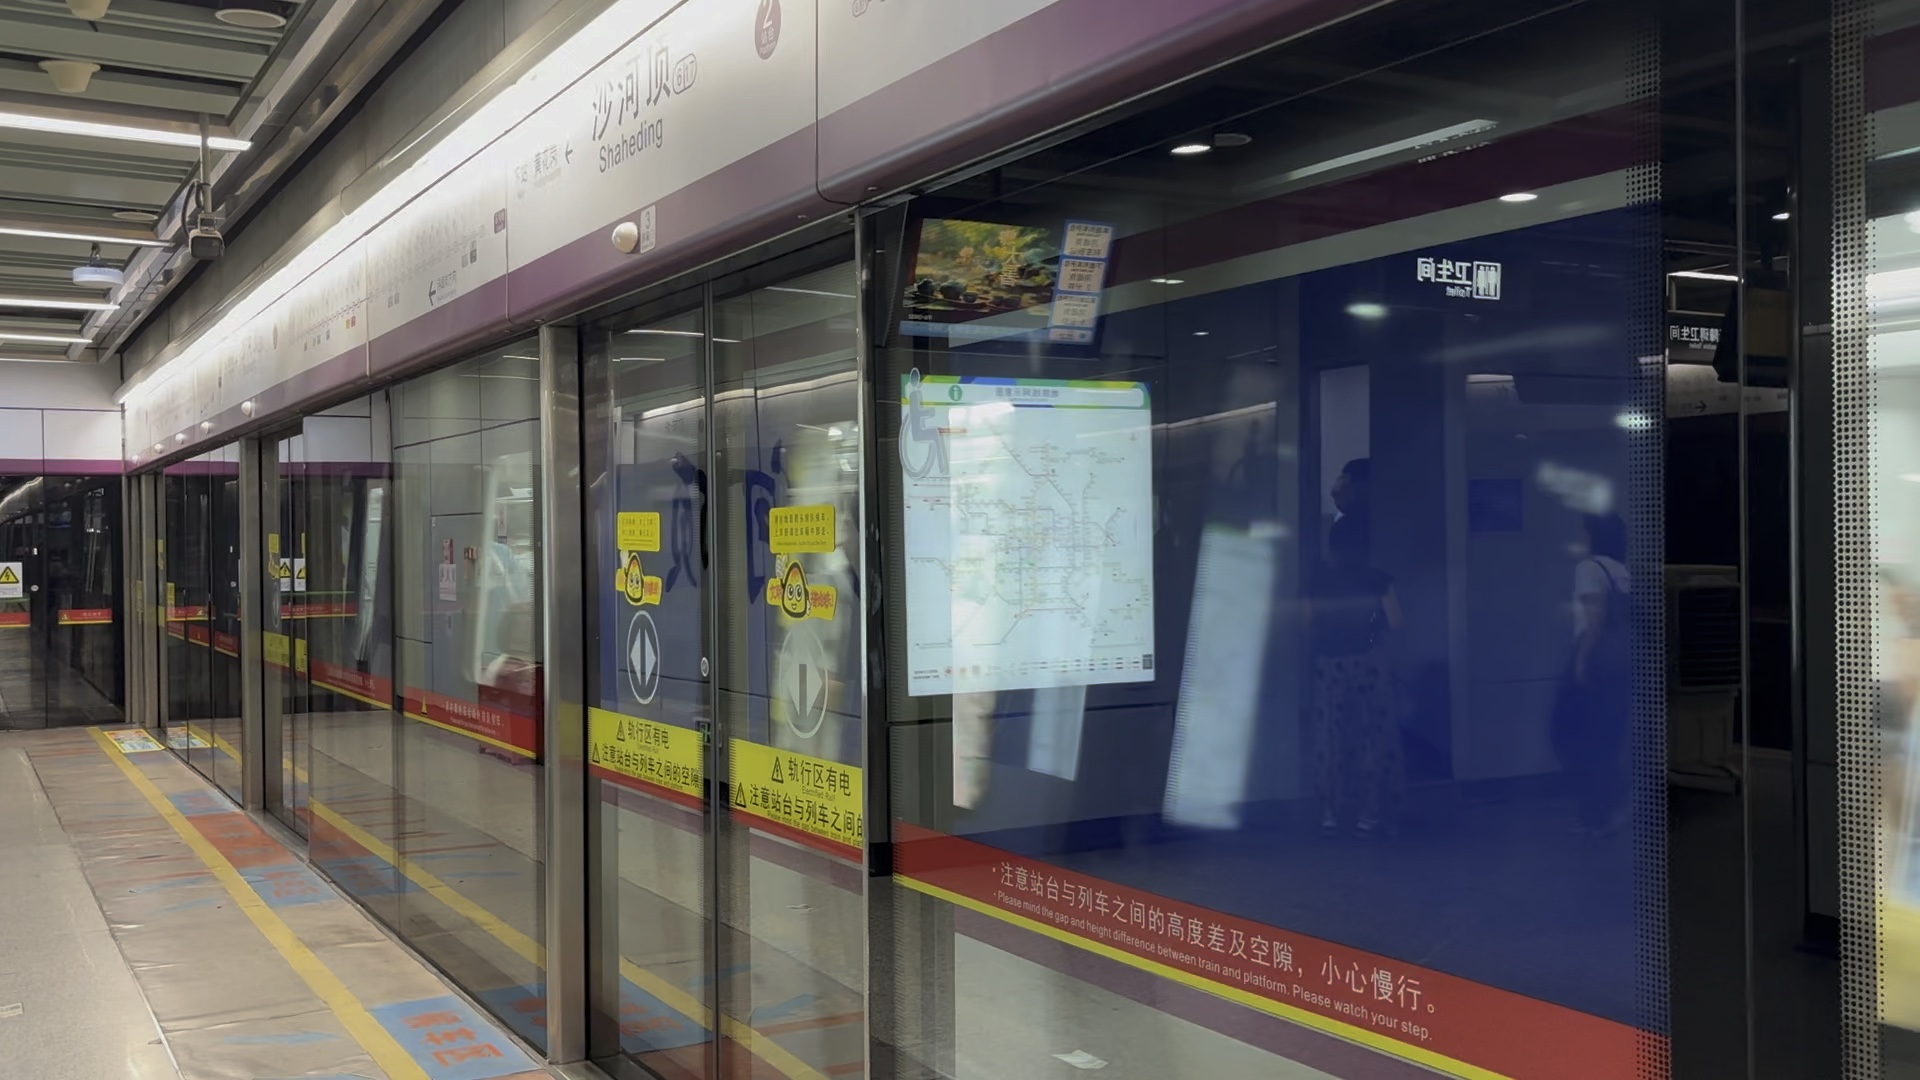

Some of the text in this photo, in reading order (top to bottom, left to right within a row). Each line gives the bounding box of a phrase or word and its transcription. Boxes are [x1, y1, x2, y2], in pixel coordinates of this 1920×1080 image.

[592, 38, 672, 141] 沙河顶
[599, 118, 663, 173] Shaheding
[628, 720, 670, 749] 轨行区有电
[788, 757, 851, 796] 轨行区有电
[997, 890, 1433, 1041] Please mind the gap and height difference between train and platform. Please watch your step.
